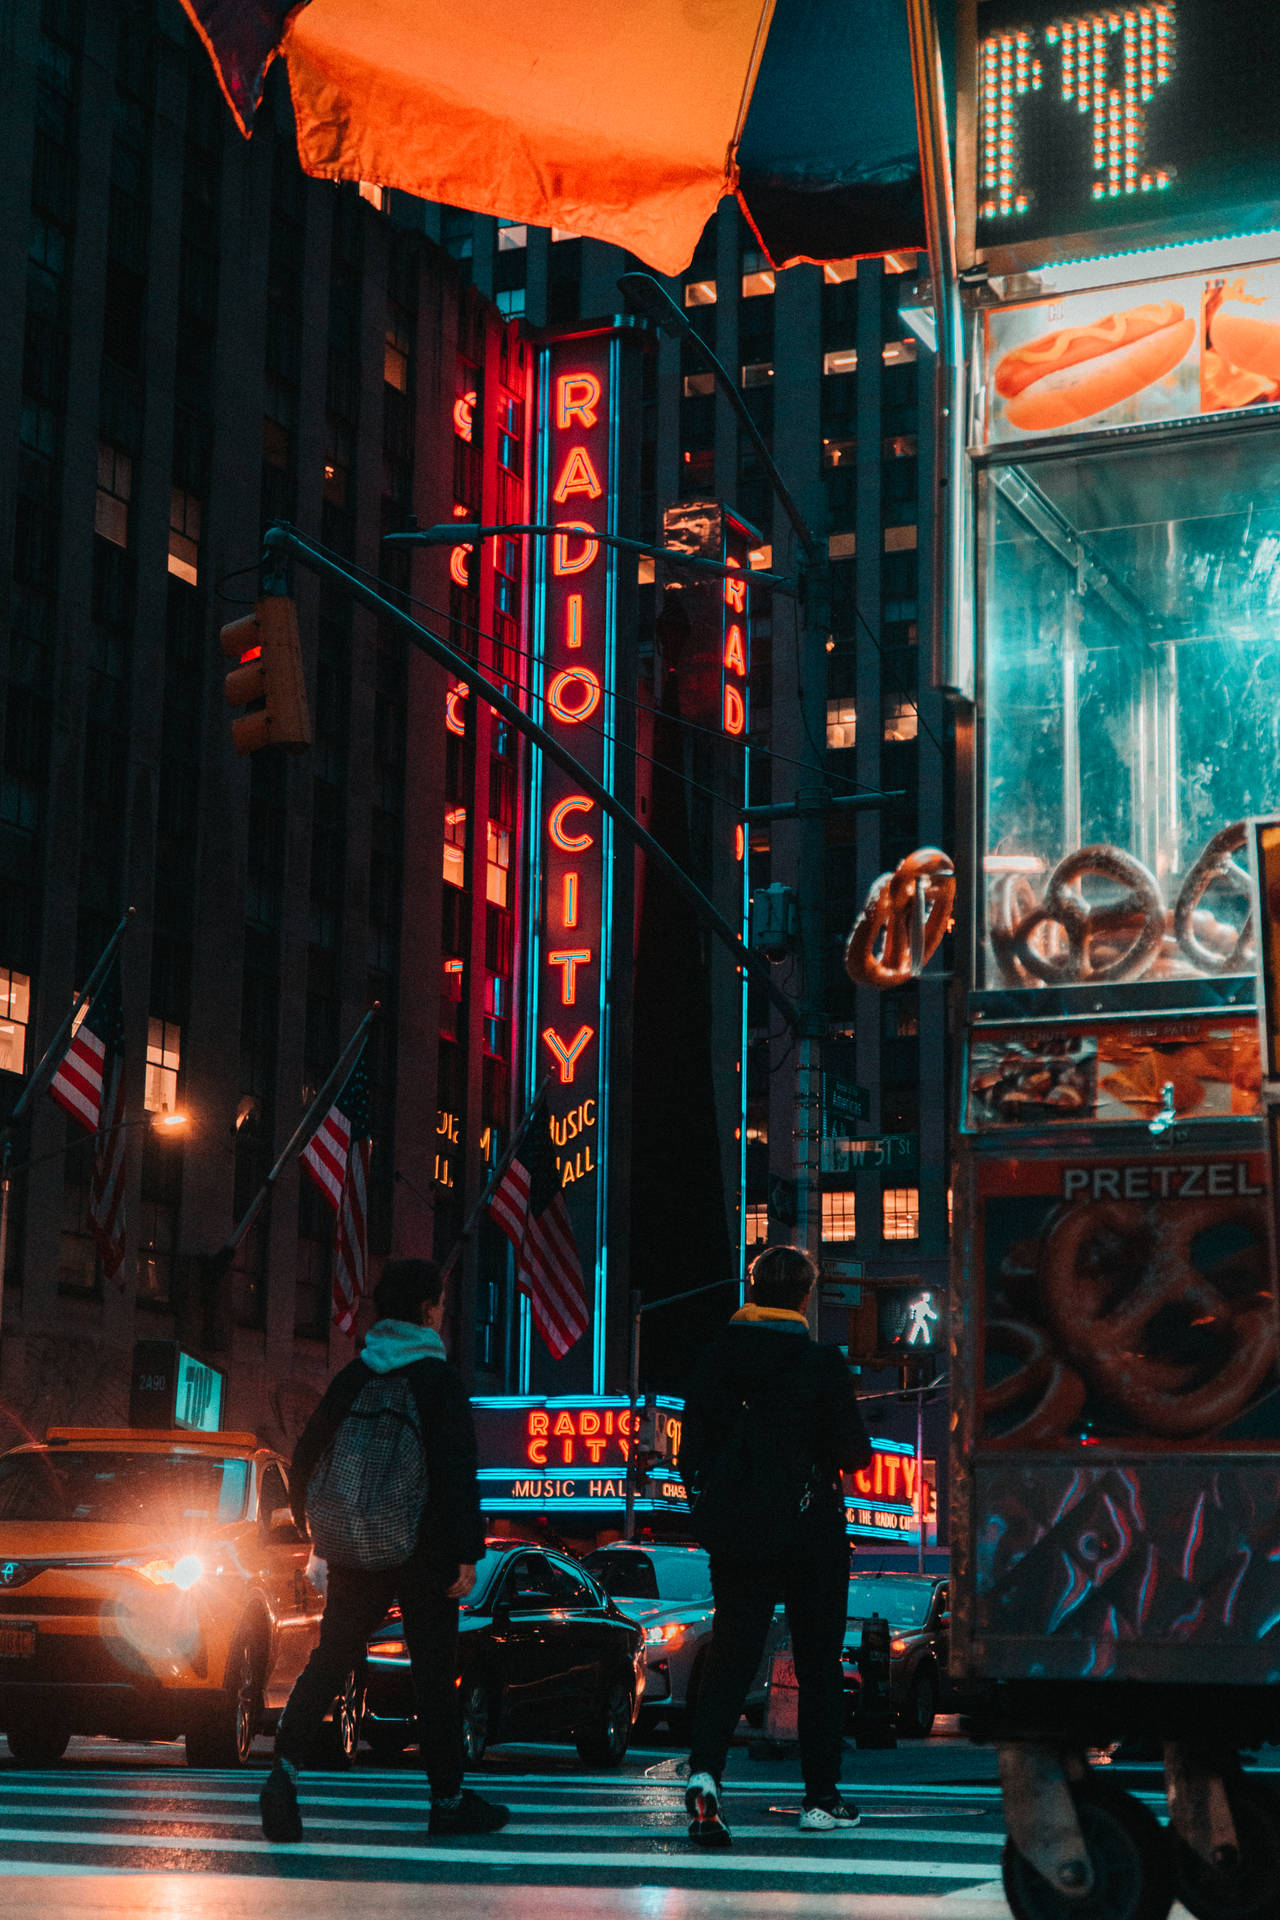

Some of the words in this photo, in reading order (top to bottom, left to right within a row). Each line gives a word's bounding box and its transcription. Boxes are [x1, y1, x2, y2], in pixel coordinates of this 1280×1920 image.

[548, 372, 602, 724] RADIO
[542, 794, 595, 1084] CITY
[555, 1144, 595, 1189] ALL
[850, 1141, 867, 1166] W
[874, 1140, 892, 1166] 51
[1063, 1162, 1264, 1201] PRETZEL
[529, 1411, 641, 1436] RADIO
[513, 1480, 576, 1498] MUSIC
[858, 1509, 873, 1525] THE
[874, 1512, 898, 1528] RADIO
